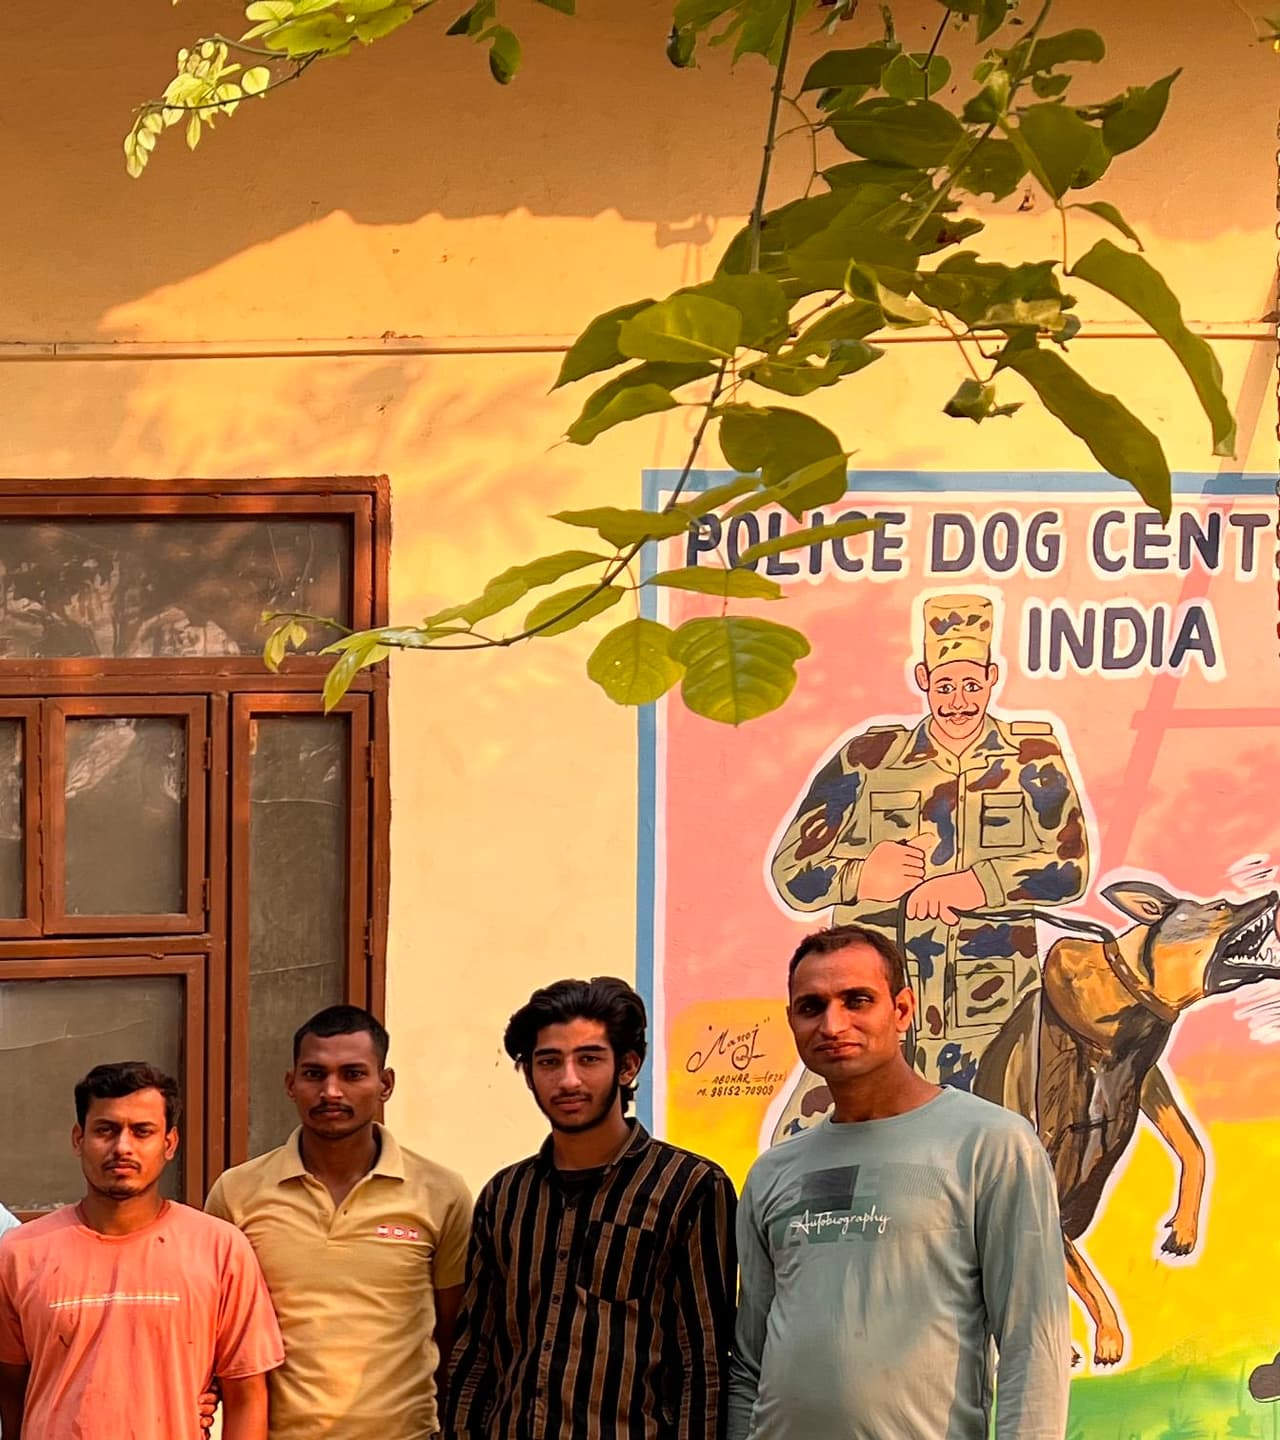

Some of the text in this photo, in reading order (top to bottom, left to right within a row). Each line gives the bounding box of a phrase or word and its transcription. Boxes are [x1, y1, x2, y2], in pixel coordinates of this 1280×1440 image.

[686, 511, 906, 576] POLICE
[931, 511, 1060, 573] DOG
[1028, 606, 1216, 672] INDIA
